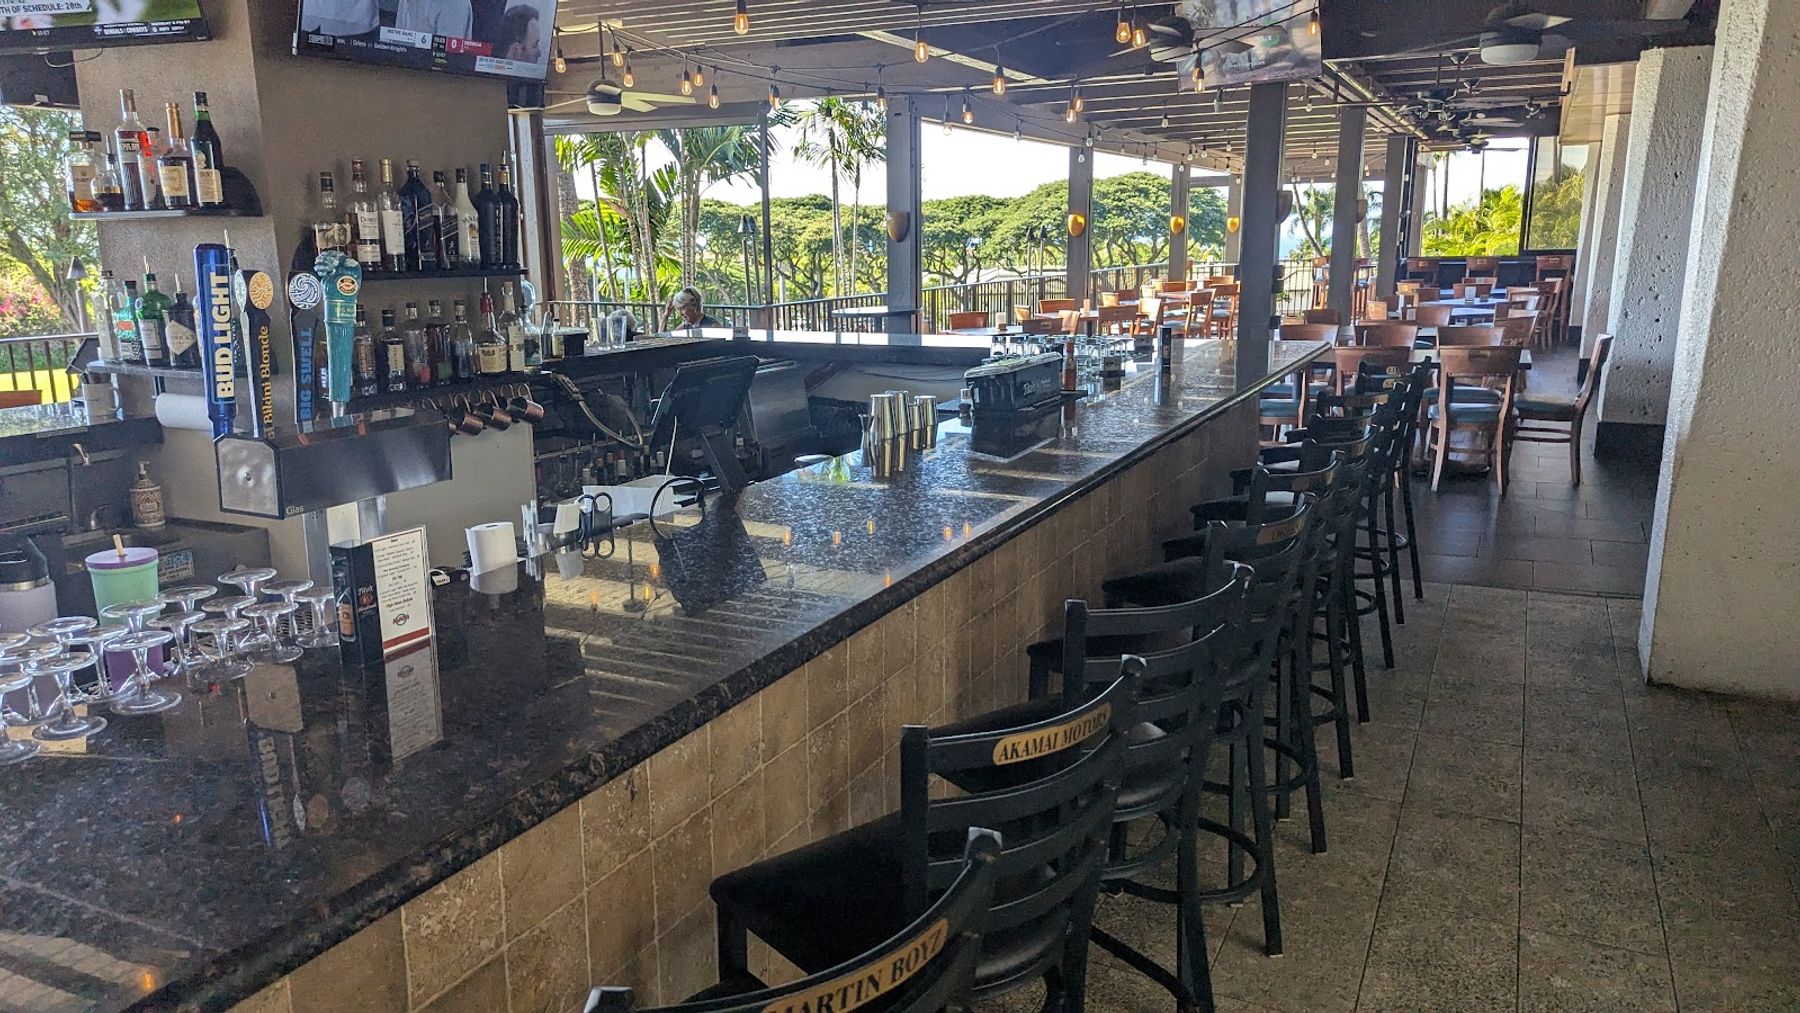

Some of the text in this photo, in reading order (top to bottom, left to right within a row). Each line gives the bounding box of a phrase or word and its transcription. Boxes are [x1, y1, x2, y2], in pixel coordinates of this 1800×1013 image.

[23, 4, 65, 13] SCHEDULE:
[65, 2, 83, 10] 28th
[421, 35, 427, 44] 6
[451, 39, 457, 48] 0
[211, 272, 235, 399] BUD LIGHT
[259, 325, 274, 424] Bikini Blonde
[301, 389, 313, 420] BIG
[999, 732, 1059, 762] AKAMAI
[890, 927, 942, 985] BOYZ
